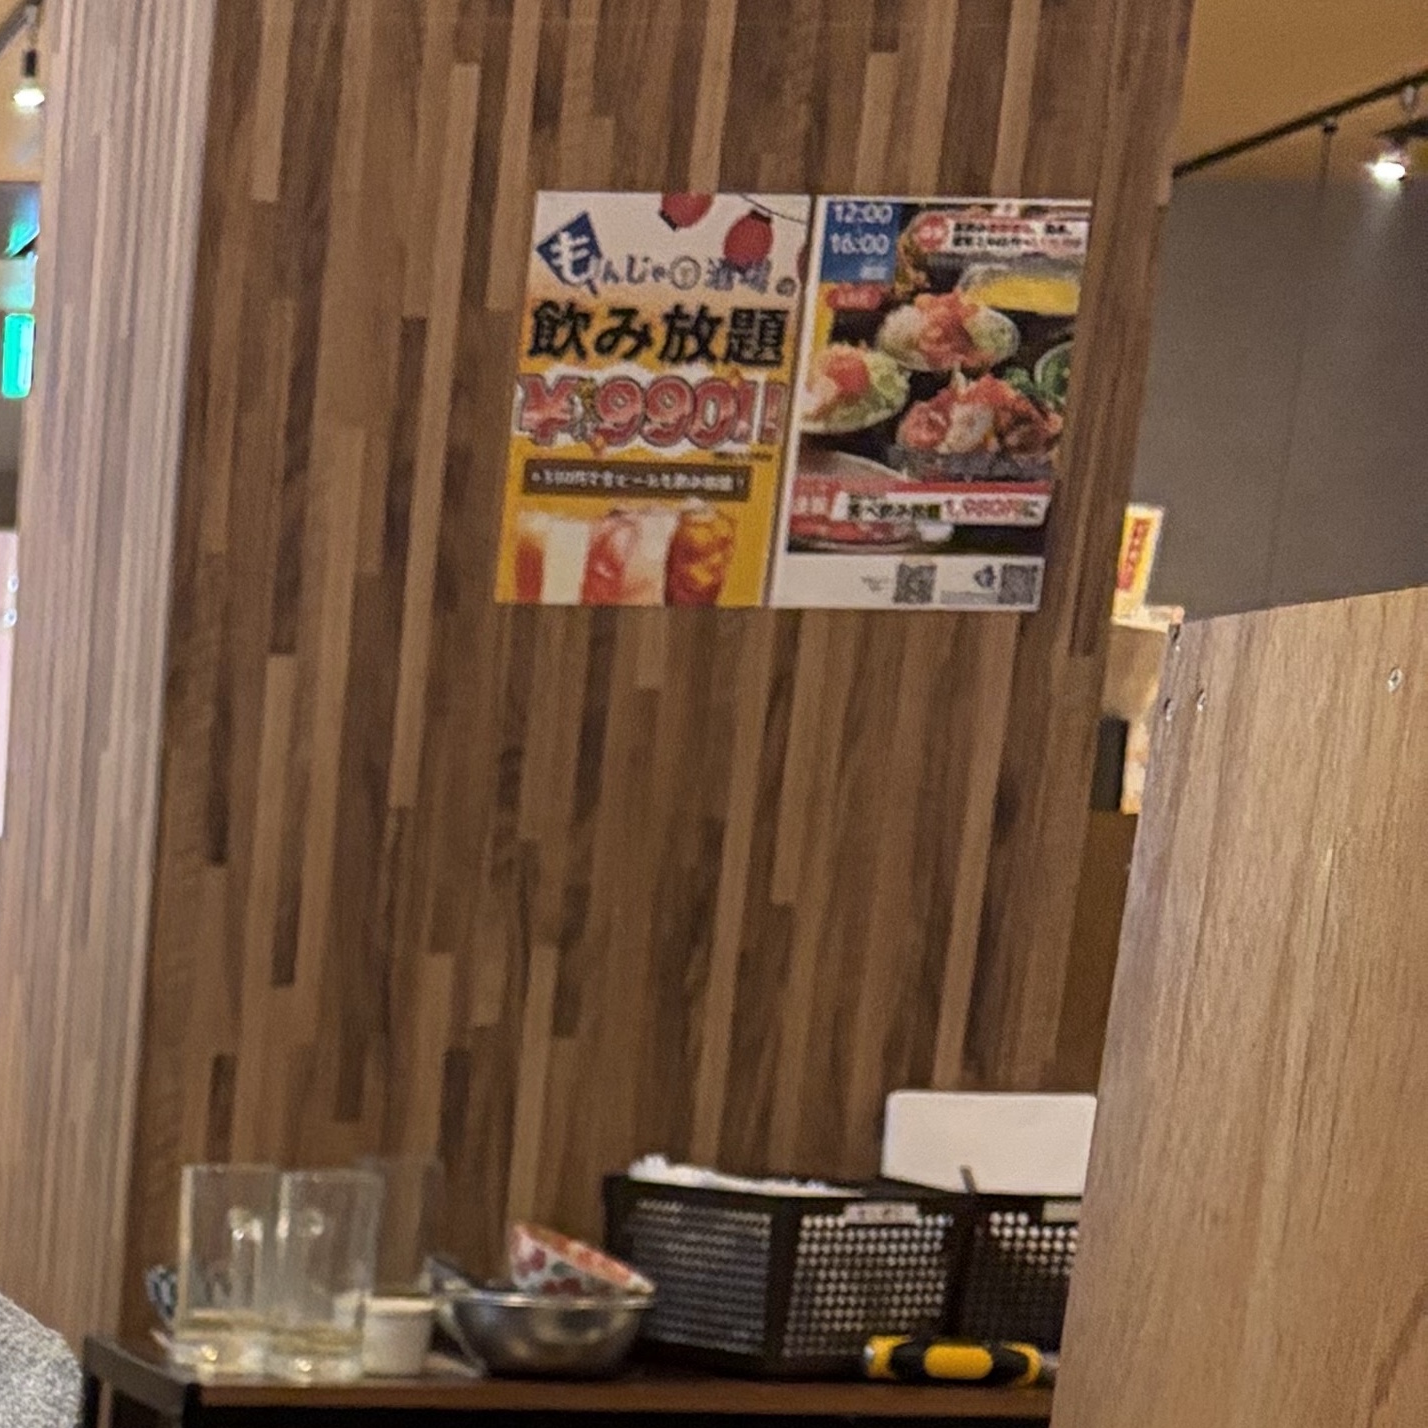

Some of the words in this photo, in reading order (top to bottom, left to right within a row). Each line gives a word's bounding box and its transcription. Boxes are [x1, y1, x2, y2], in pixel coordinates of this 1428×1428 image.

[831, 203, 894, 226] 12:00
[829, 232, 890, 256] 16:00
[527, 300, 790, 368] 飲み放題
